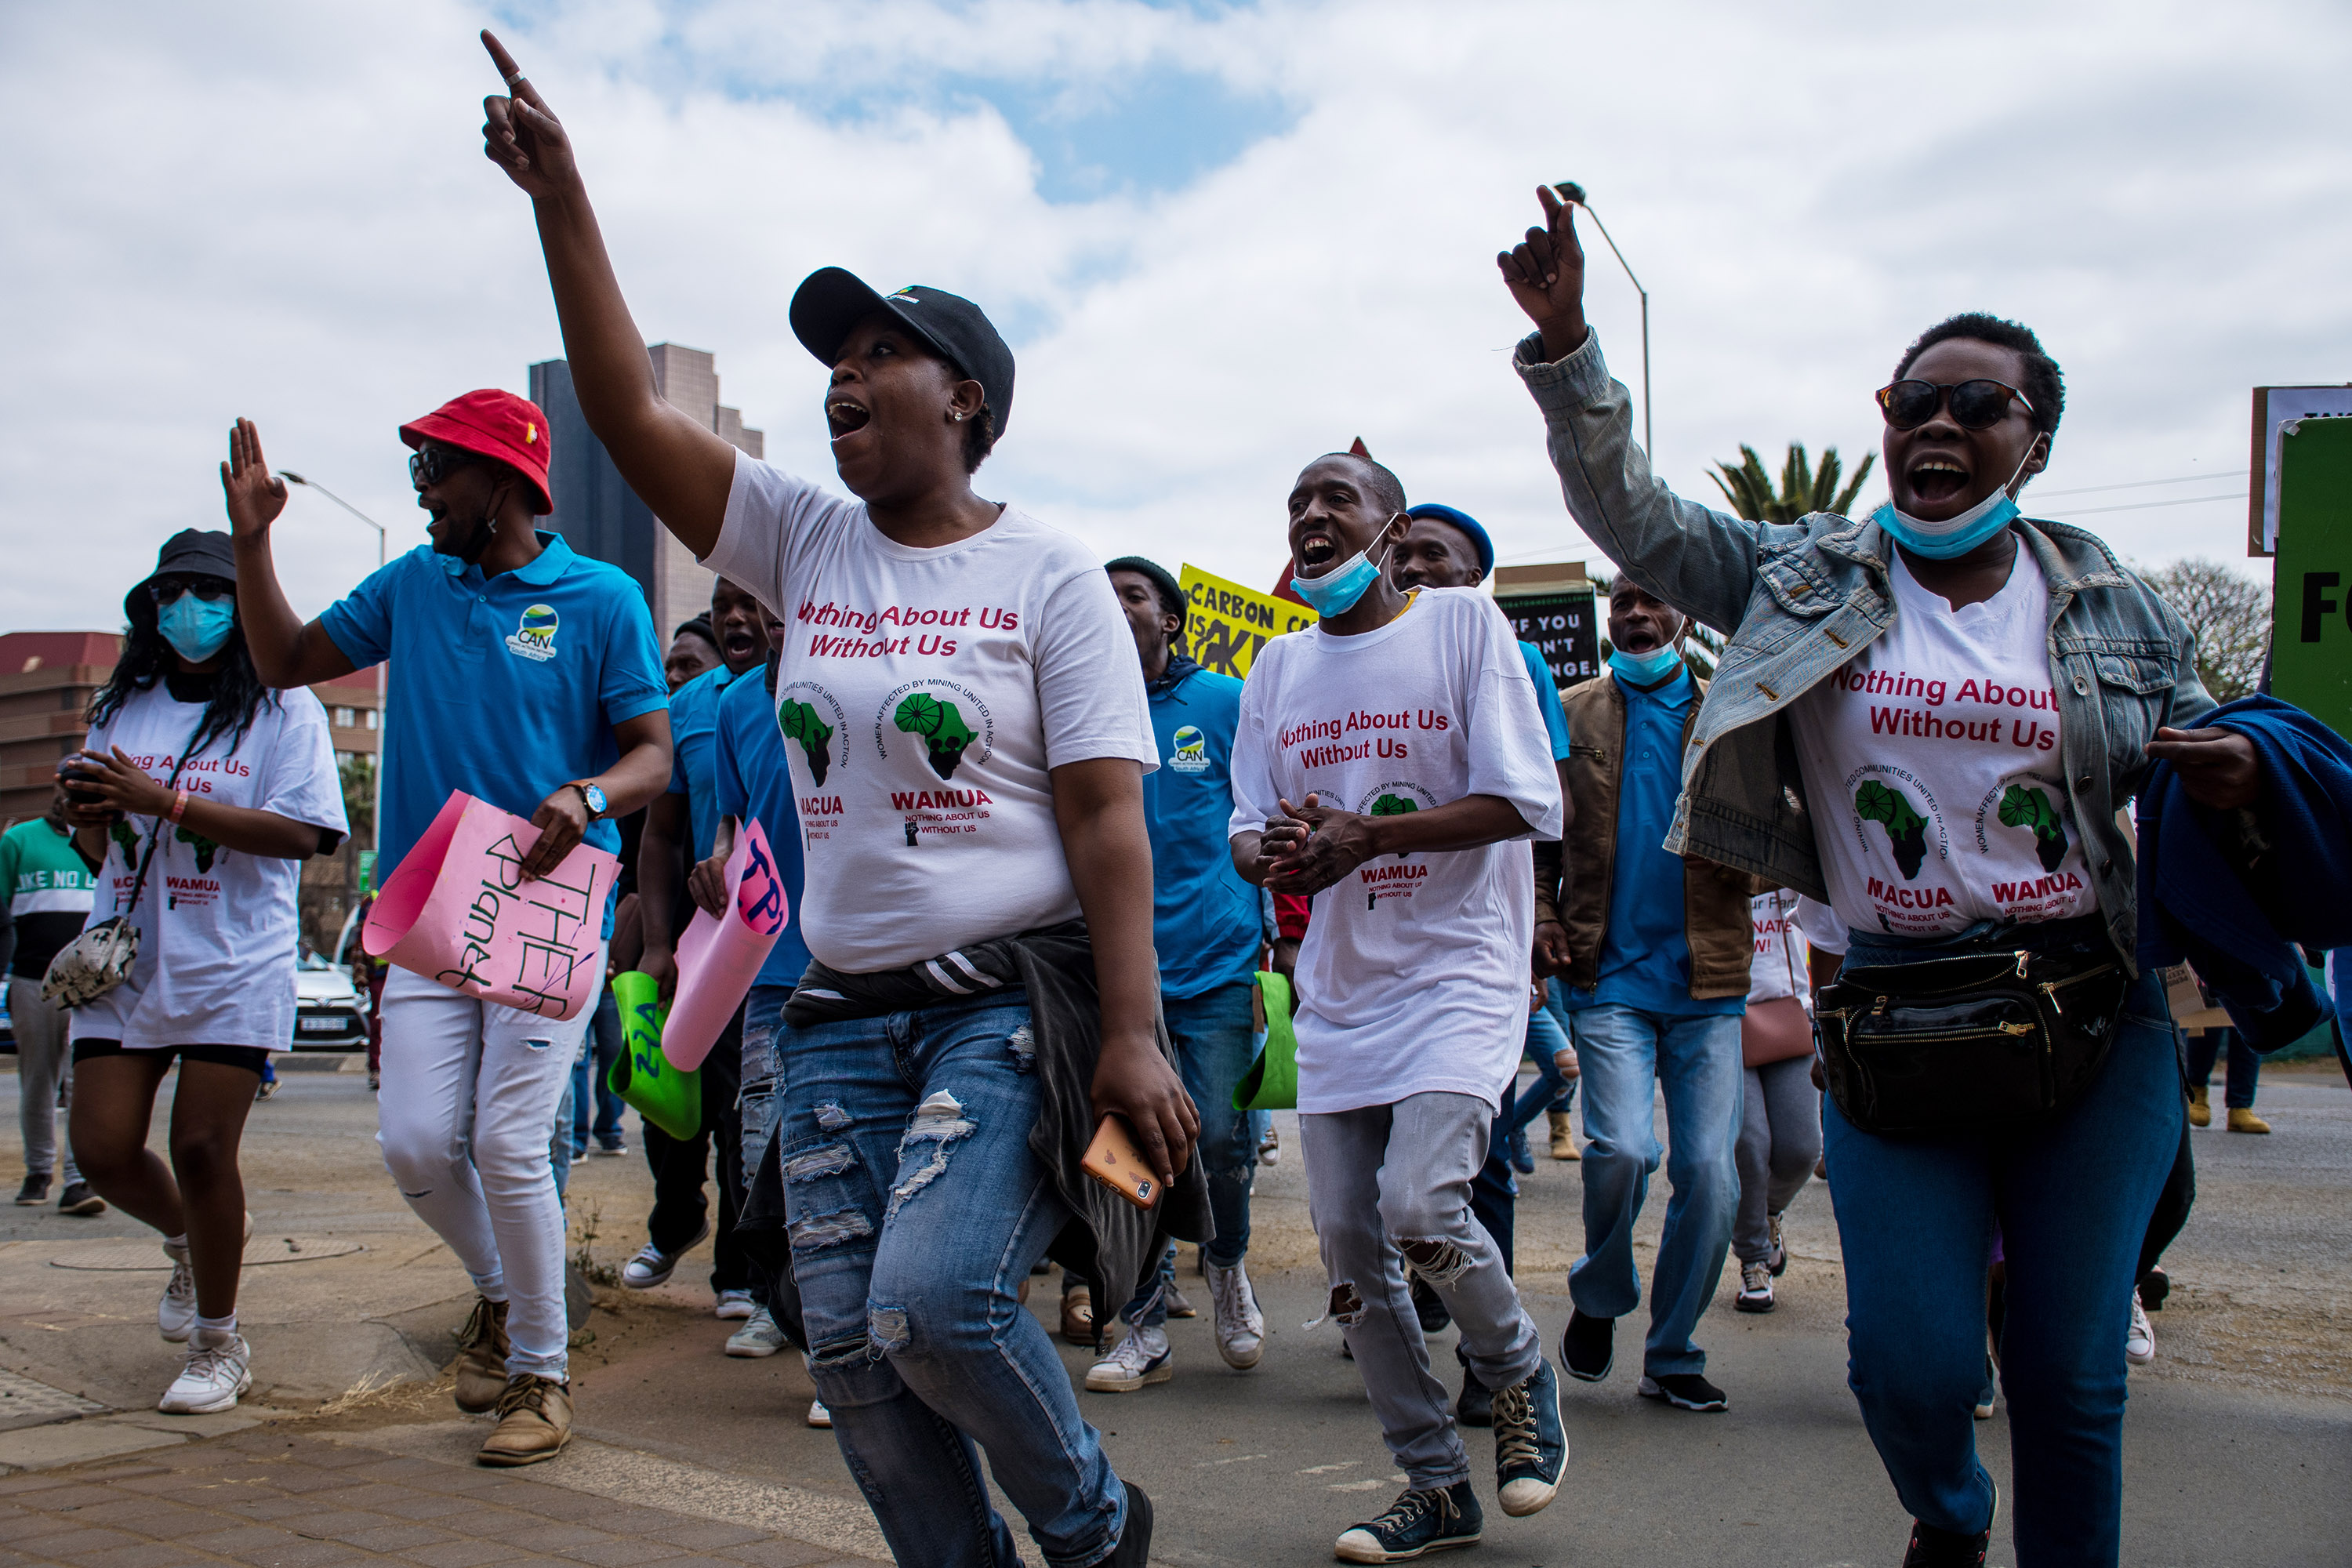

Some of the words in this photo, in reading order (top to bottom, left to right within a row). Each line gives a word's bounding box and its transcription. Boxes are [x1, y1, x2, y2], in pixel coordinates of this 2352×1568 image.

[879, 604, 971, 628] About
[978, 607, 1018, 631] Us
[1191, 583, 1275, 630] CARBON
[1188, 612, 1206, 638] IS
[1537, 614, 1580, 631] YOU
[519, 630, 550, 650] CAN
[808, 633, 911, 659] Without
[917, 633, 957, 657] Us
[1548, 660, 1599, 678] NGE.
[912, 679, 924, 688] BY
[927, 678, 962, 691] MINING
[1830, 666, 1947, 706] Nothing
[1955, 678, 2060, 713] About
[822, 690, 844, 720] UNITED
[877, 684, 910, 722] AFFECTED
[963, 688, 990, 717] UNITED
[840, 720, 848, 731] IN
[985, 718, 994, 729] IN
[1281, 718, 1342, 751] Nothing
[1345, 710, 1410, 732] About
[1417, 709, 1449, 731] Us
[1870, 706, 2002, 743] Without
[2012, 719, 2056, 751] Us
[840, 732, 849, 769] ACTION
[875, 723, 887, 760] WOMEN
[978, 730, 994, 766] ACTION
[1177, 750, 1203, 761] CAN
[1300, 739, 1370, 770] Without
[1377, 738, 1408, 759] Us
[159, 754, 220, 772] Aout
[224, 758, 251, 777] Us
[1855, 764, 1913, 782] COMMUNITIES
[187, 776, 212, 793] Us
[1392, 781, 1416, 789] MINING
[1416, 785, 1437, 806] UNITED
[1913, 779, 1938, 812] UNITED
[891, 789, 994, 811] WAMUA
[1977, 778, 2006, 817] AFFECTED
[905, 814, 943, 822] NOTHING
[945, 811, 975, 822] ABOUT
[978, 810, 990, 819] US
[1934, 813, 1943, 823] IN
[921, 826, 961, 834] WITHOUT
[964, 824, 977, 833] US
[1853, 816, 1869, 853] MINING
[1975, 816, 1989, 855] WOMEN
[1938, 825, 1948, 862] ACTION
[53, 870, 79, 888] NO
[166, 876, 221, 893] WAMUA
[1360, 865, 1428, 884] WAMUA
[1368, 884, 1391, 893] NOTHING
[1377, 891, 1402, 900] WITHOUT
[1867, 876, 1955, 909] MACUA
[1991, 872, 2084, 903] WAMUA
[1875, 903, 1906, 921] NOTHING
[1907, 913, 1935, 922] ABOUT
[1936, 911, 1951, 920] US
[2005, 903, 2042, 916] NOTHING
[2044, 896, 2067, 911] ABOUT
[2068, 895, 2077, 903] US
[2056, 908, 2064, 917] US
[1752, 919, 1792, 934] NATE
[1889, 920, 1926, 932] WITHOUT
